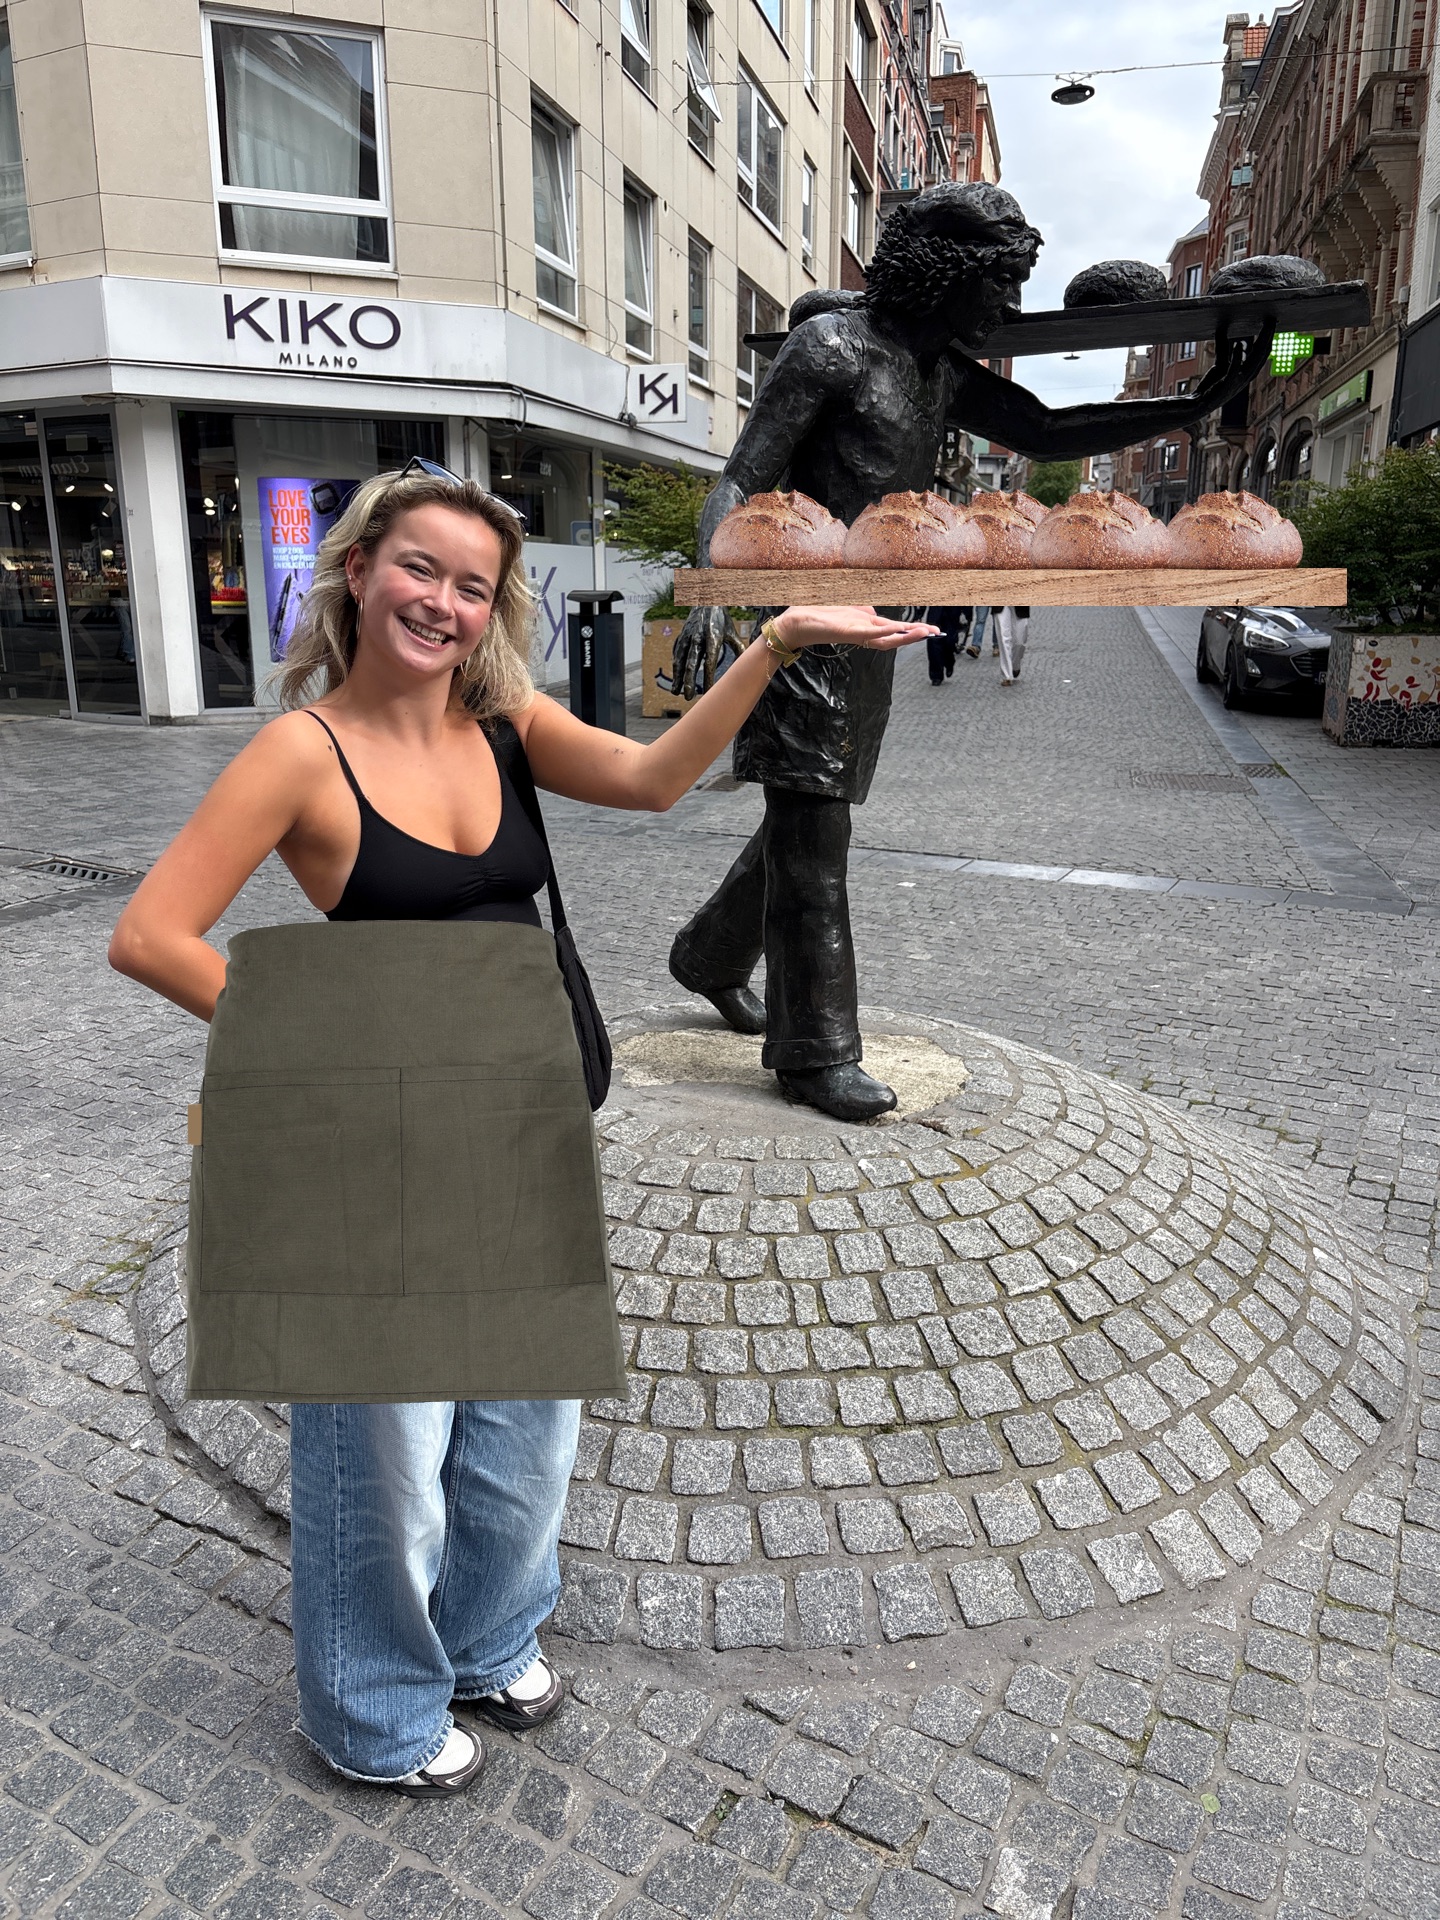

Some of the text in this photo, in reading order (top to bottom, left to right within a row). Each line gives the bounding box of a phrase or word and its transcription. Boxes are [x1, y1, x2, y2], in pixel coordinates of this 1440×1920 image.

[223, 293, 401, 350] KIKO
[278, 352, 358, 369] MILANO
[268, 489, 306, 508] LOVE
[270, 508, 311, 526] YOUR
[271, 527, 310, 545] EYES
[583, 640, 592, 668] leuven
